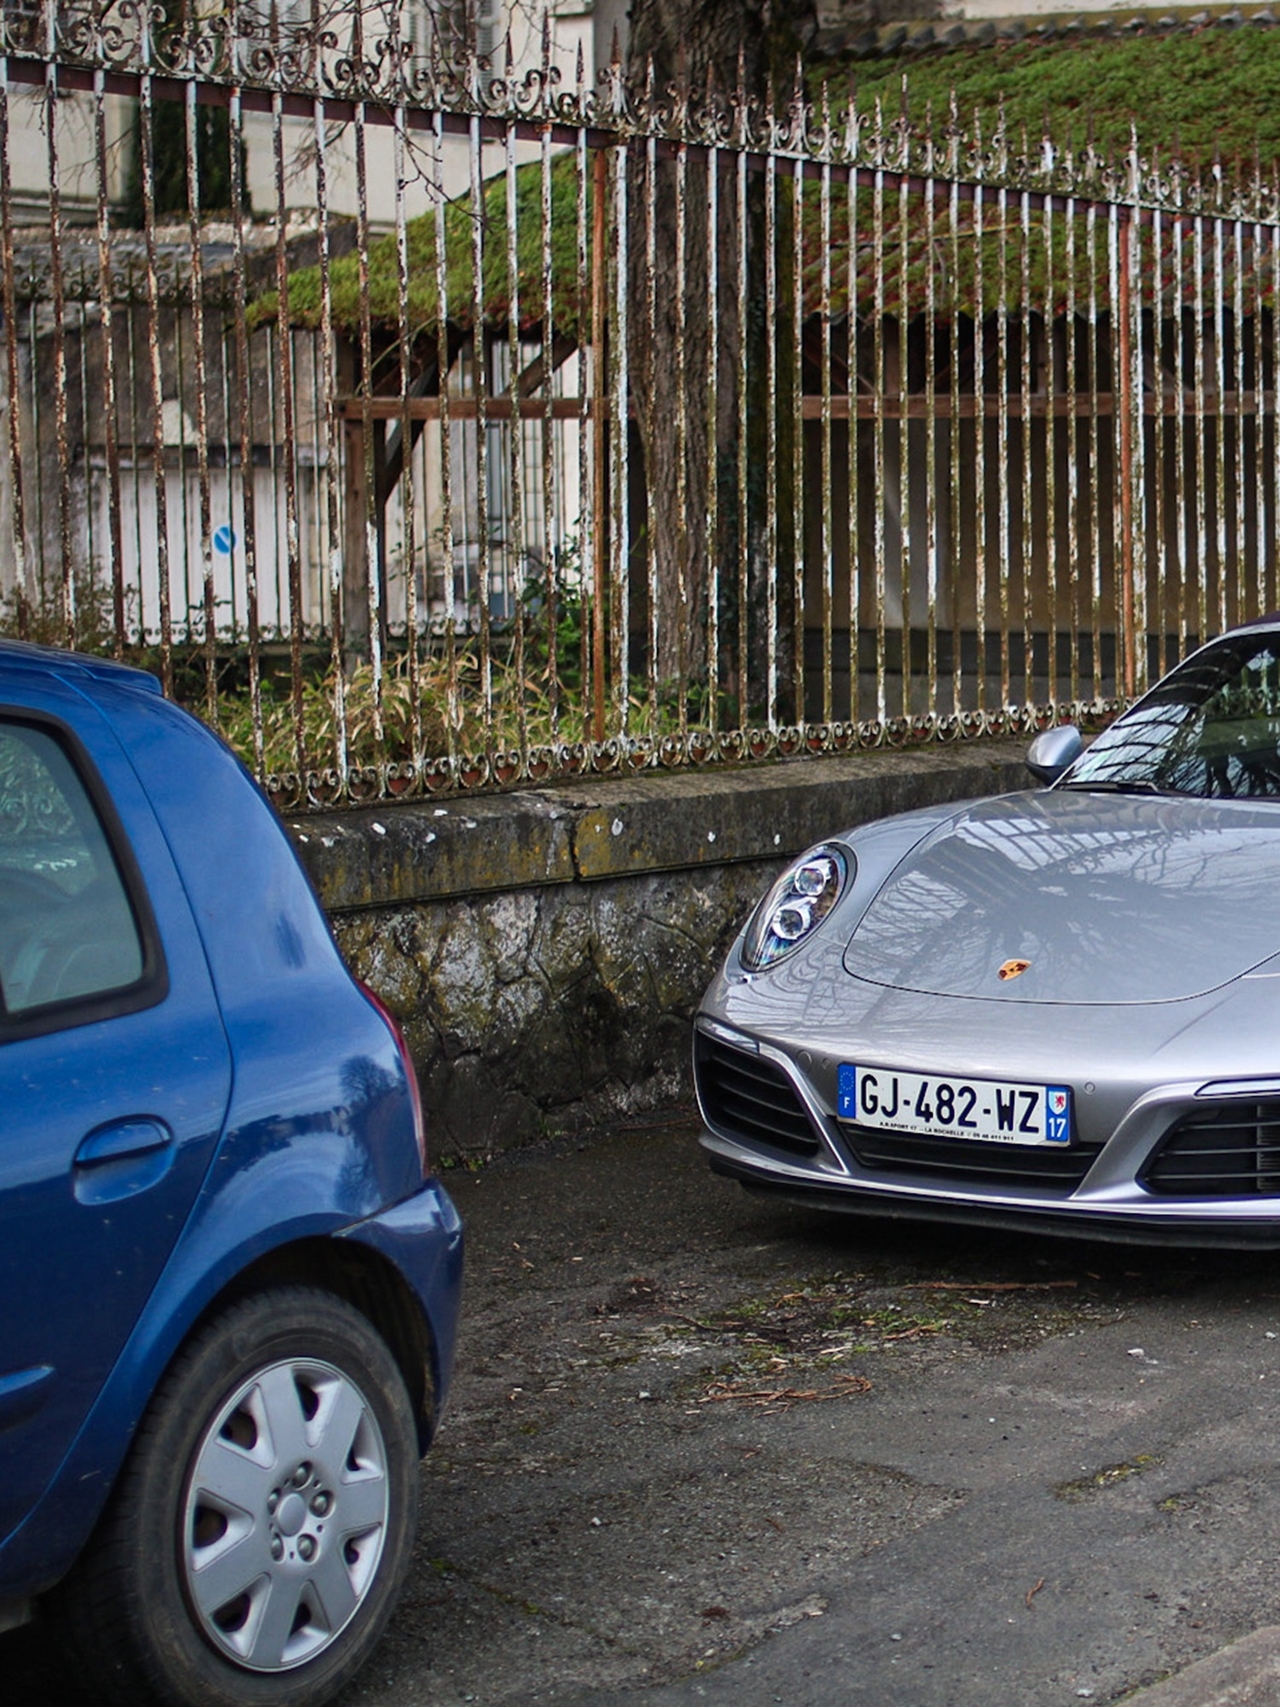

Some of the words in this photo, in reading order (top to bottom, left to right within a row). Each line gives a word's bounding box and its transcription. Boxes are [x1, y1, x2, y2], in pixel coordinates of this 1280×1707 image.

[844, 1096, 851, 1109] F
[861, 1074, 1039, 1134] GJ-482-WZ
[934, 1128, 965, 1136] ROCHELLE
[1048, 1117, 1067, 1138] 17
